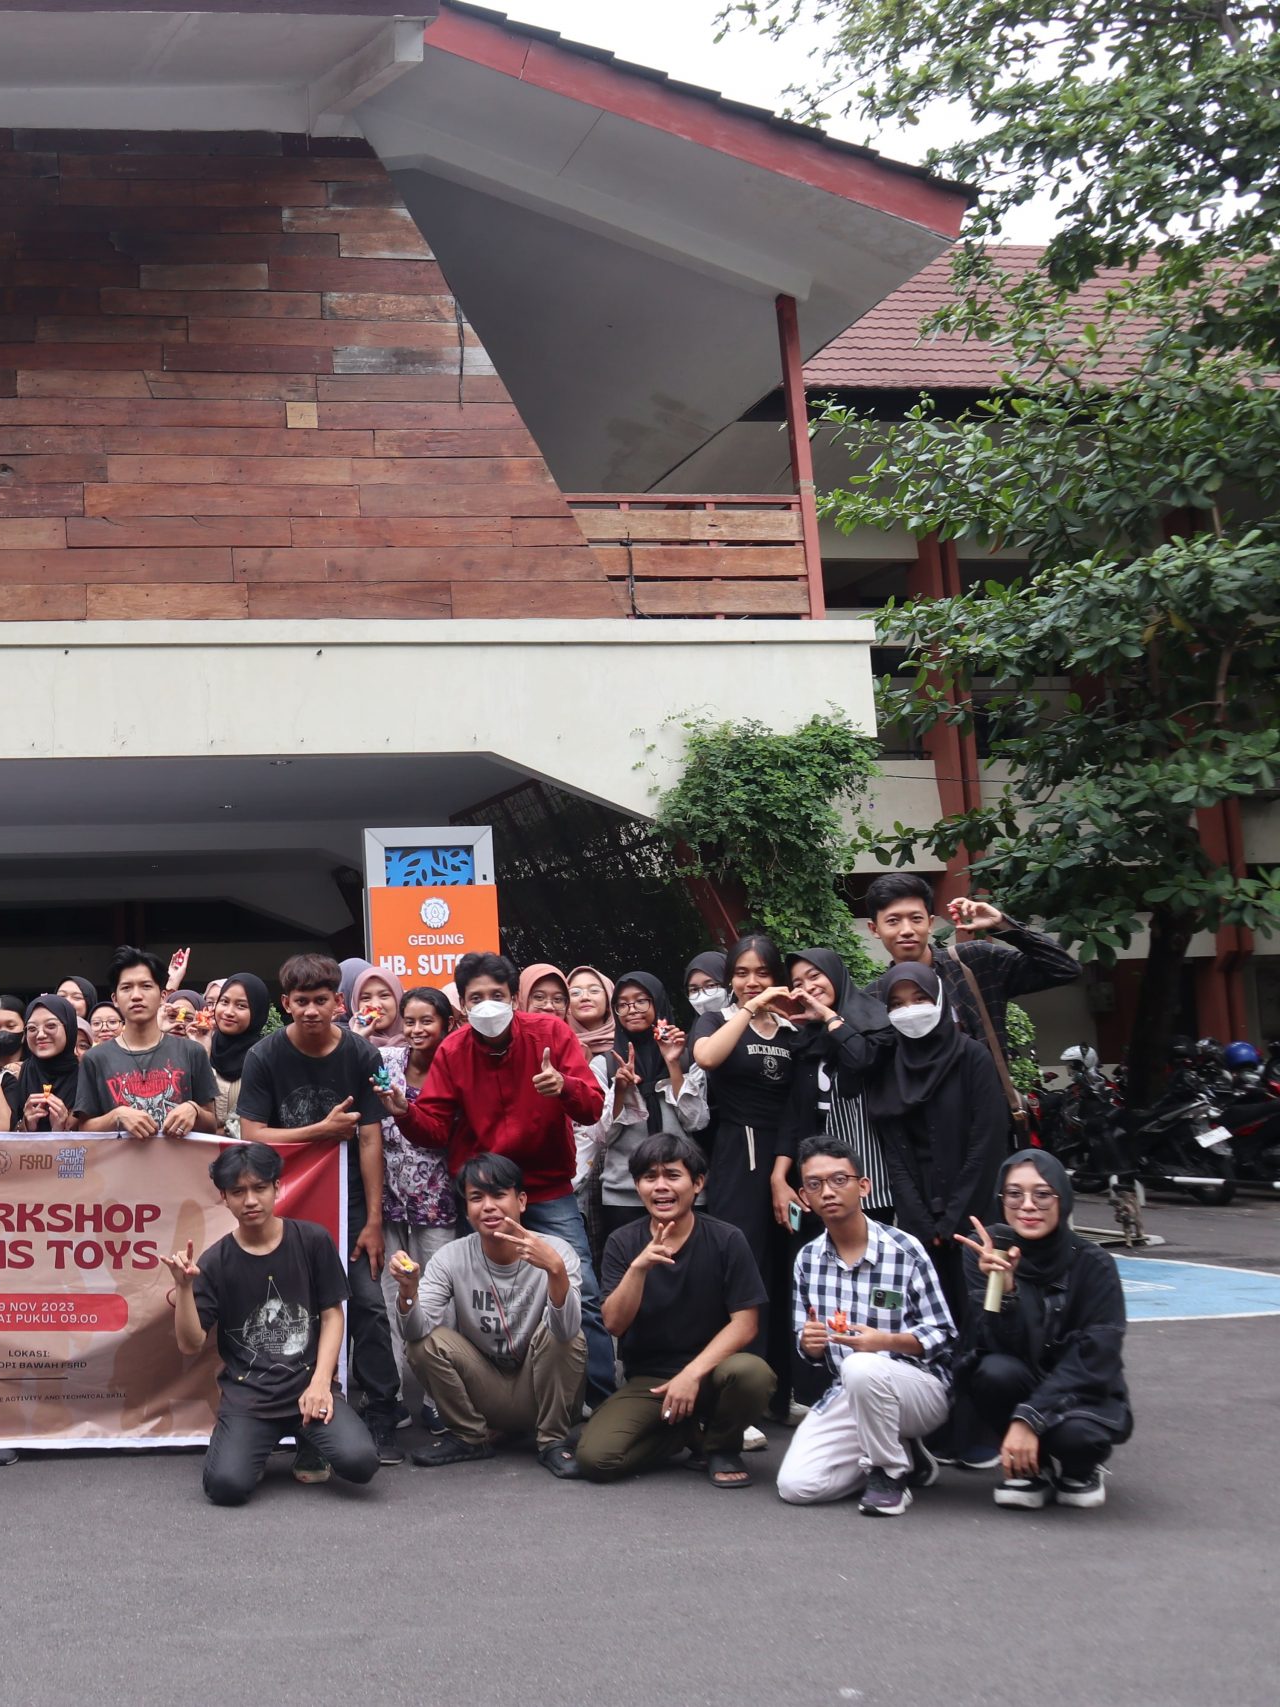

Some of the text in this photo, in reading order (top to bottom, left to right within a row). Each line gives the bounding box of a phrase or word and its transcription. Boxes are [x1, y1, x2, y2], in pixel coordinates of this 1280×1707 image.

[408, 934, 464, 945] GEDUNG
[380, 955, 411, 975] HB.
[19, 1154, 53, 1170] FSRD
[46, 1240, 160, 1270] TOYS
[10, 1302, 36, 1312] NOV
[41, 1302, 75, 1312] 2023
[15, 1314, 57, 1324] PUKUL
[60, 1314, 98, 1324] 09.00
[8, 1350, 50, 1358] LOKASI:
[61, 1361, 87, 1369] FSRD
